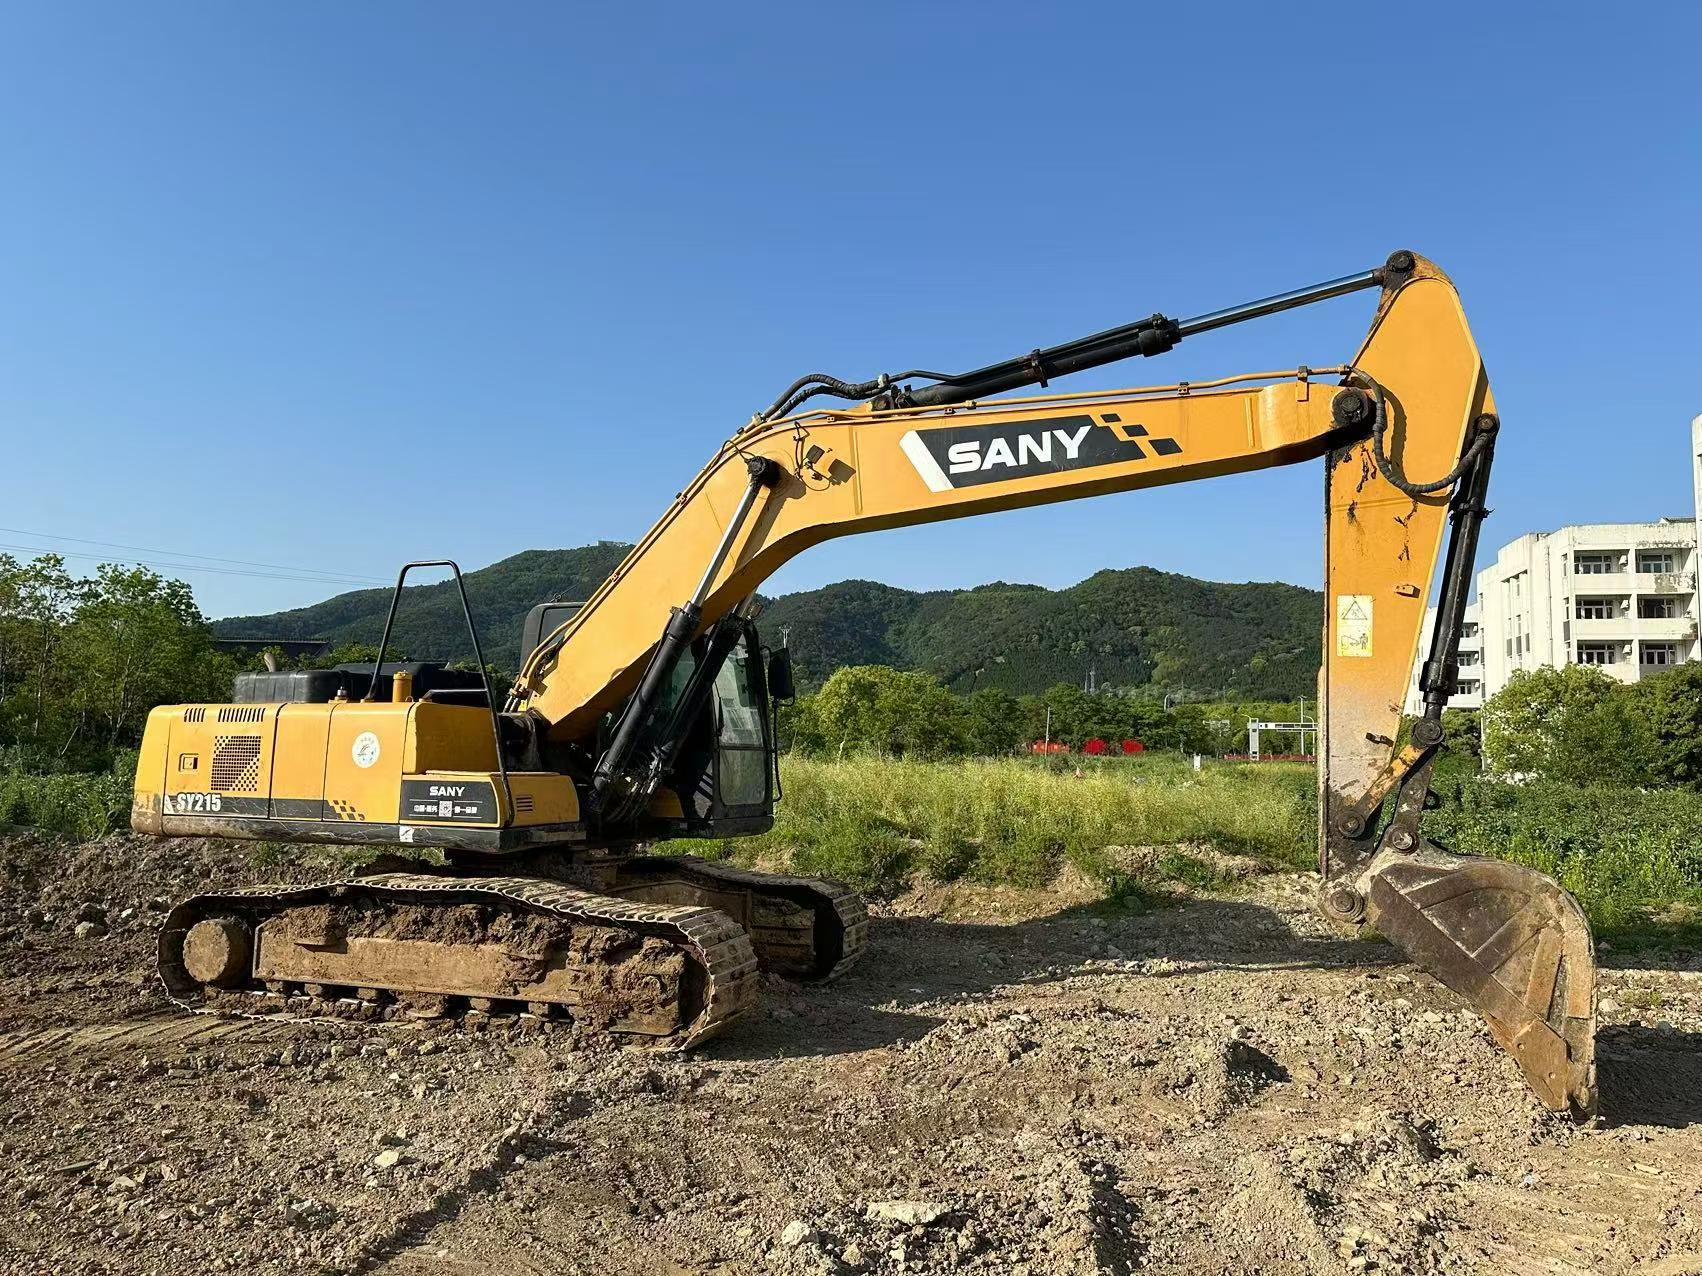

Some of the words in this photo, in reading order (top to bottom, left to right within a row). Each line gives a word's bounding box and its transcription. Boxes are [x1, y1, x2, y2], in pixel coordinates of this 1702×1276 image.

[948, 425, 1092, 474] SANY
[429, 786, 465, 797] SANY
[176, 793, 221, 812] SY215
